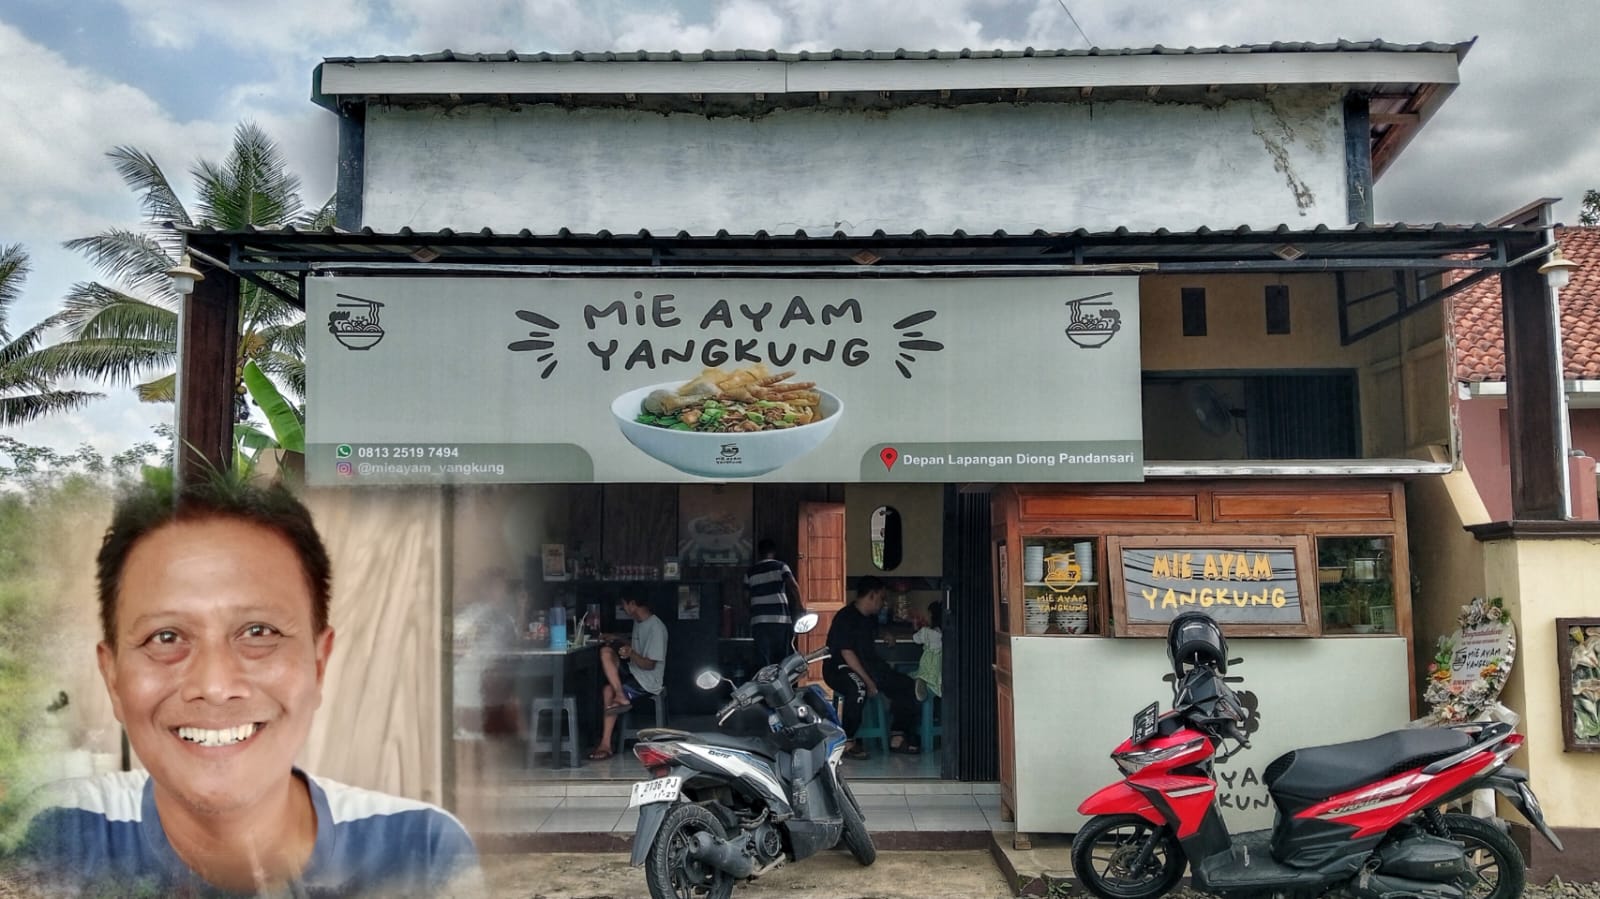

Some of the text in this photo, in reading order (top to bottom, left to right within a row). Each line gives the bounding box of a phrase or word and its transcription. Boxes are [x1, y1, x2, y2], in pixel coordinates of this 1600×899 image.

[700, 296, 862, 332] AYAM
[587, 338, 870, 371] YANGKUNG
[358, 447, 459, 458] 0813 2519 7494
[903, 452, 1134, 467] Depan Lapangan Diong Pandansari
[358, 462, 505, 475] @mieayam_yangkung
[1152, 552, 1273, 580] MIE AYAM
[1057, 594, 1087, 603] AYAM
[1141, 587, 1287, 610] YANGKUNG
